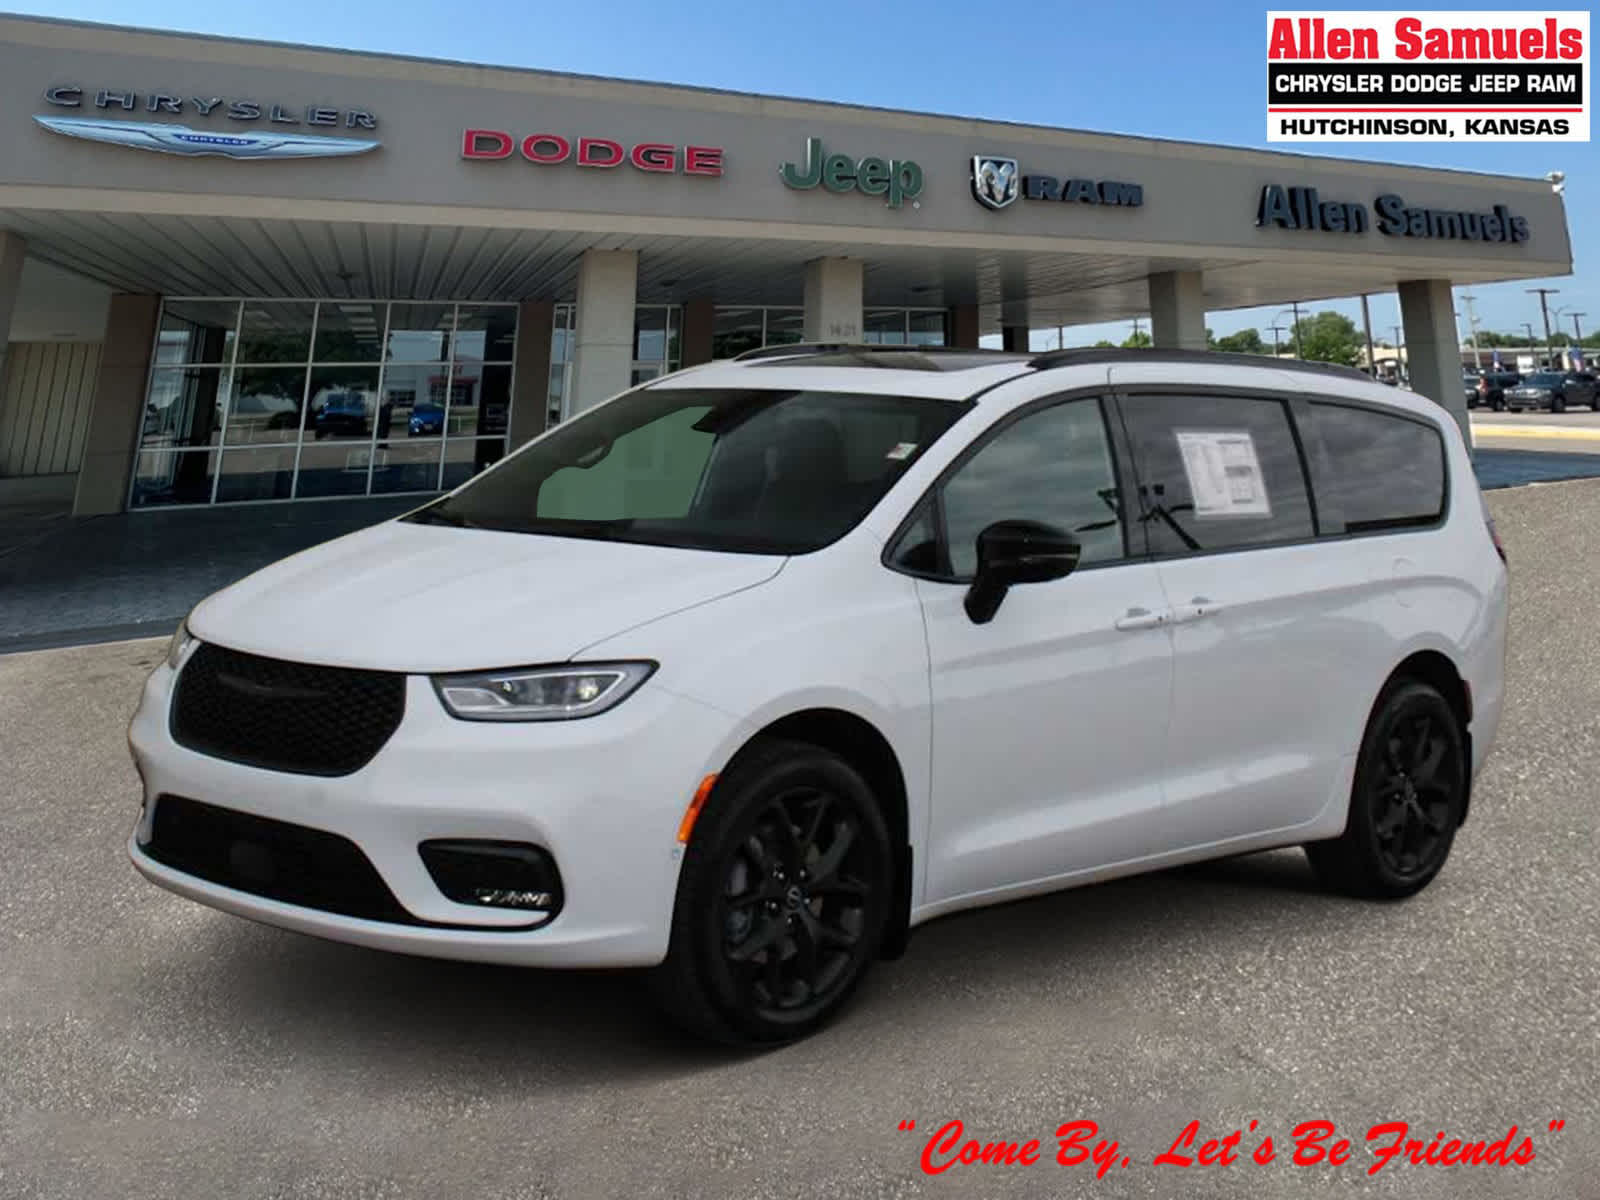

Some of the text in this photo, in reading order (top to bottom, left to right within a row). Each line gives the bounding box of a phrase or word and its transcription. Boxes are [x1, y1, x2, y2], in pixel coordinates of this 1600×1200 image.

[43, 86, 378, 129] CHRYSLER
[461, 128, 724, 177] DODGE
[779, 136, 924, 209] Jeep
[1022, 175, 1144, 207] RAM
[1255, 184, 1531, 243] Allen Samuels
